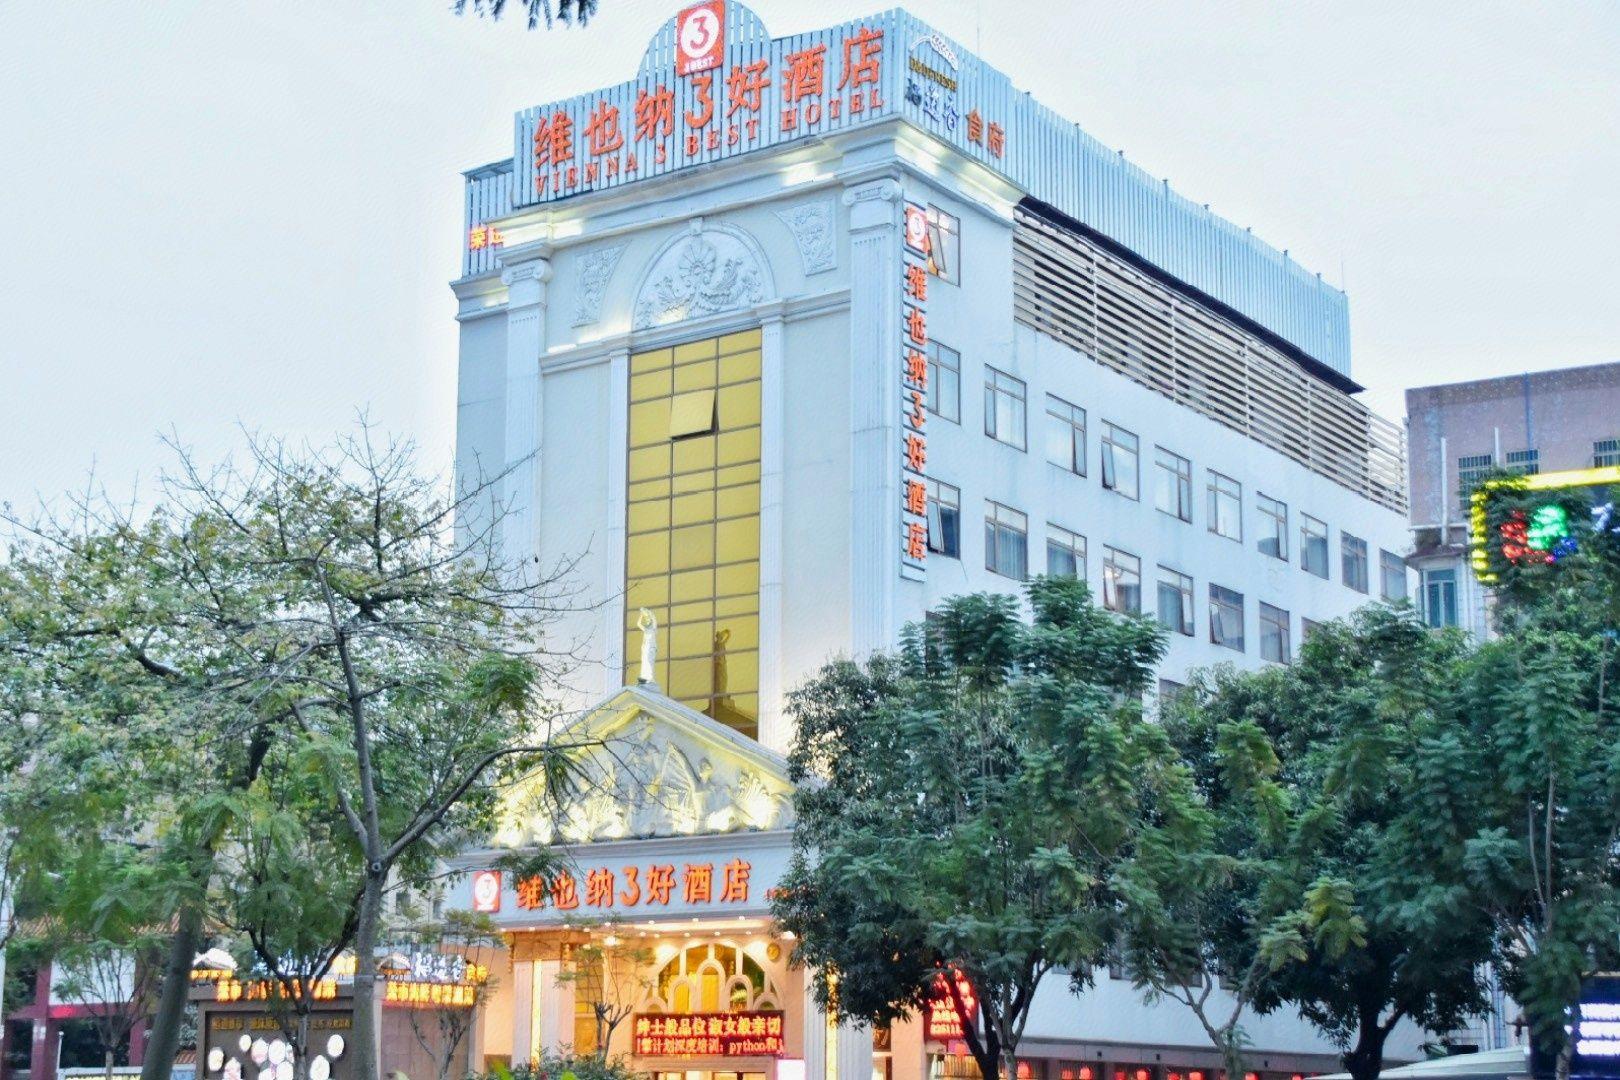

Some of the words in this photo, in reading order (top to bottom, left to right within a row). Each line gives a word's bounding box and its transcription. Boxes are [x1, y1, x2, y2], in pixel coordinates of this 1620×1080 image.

[690, 16, 710, 50] 3
[534, 26, 885, 168] 维也纳3好酒店
[534, 152, 639, 197] VIENNA
[656, 143, 667, 164] 3
[686, 119, 759, 156] BEST
[781, 88, 885, 132] HOTEL
[907, 264, 927, 561] 维也纳3好酒店
[516, 858, 752, 911] 维也纳3好酒店
